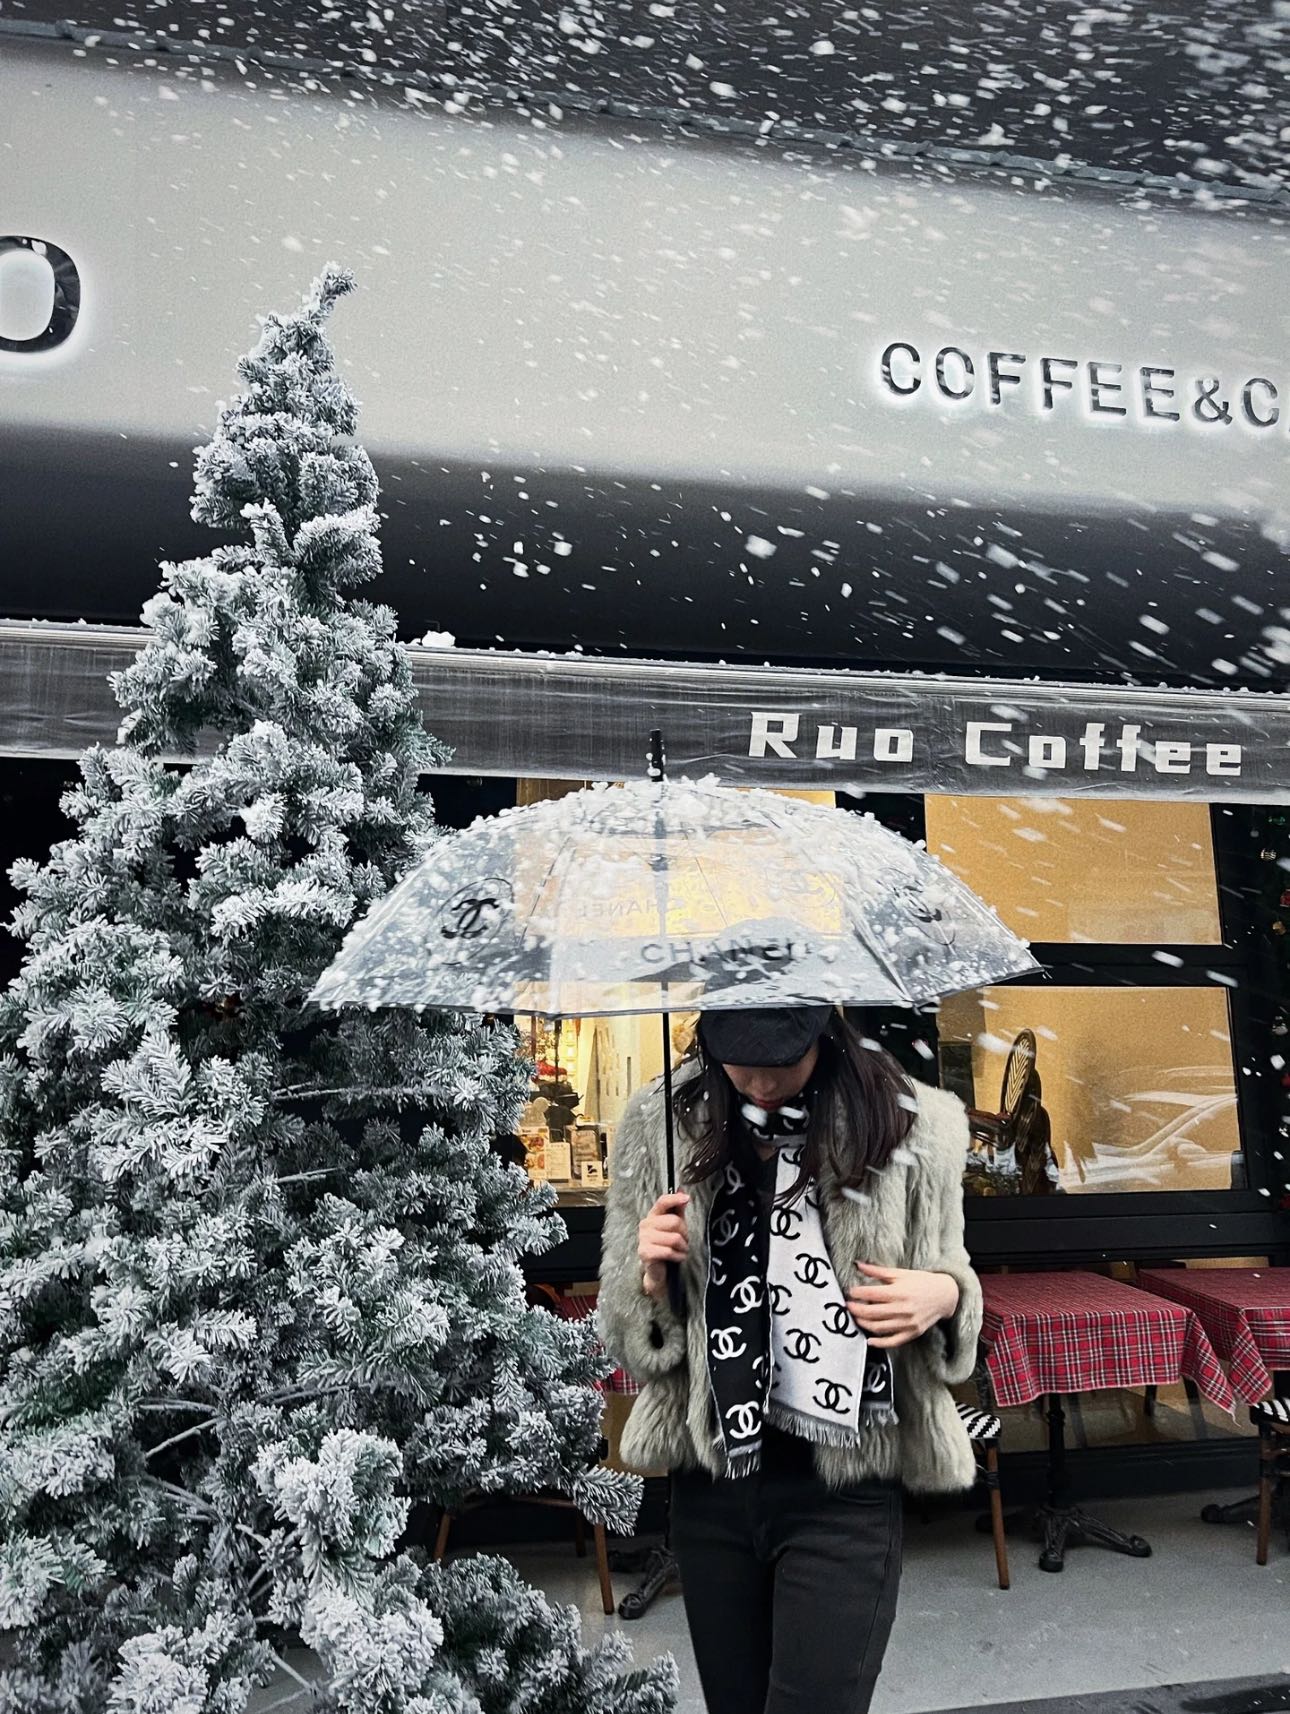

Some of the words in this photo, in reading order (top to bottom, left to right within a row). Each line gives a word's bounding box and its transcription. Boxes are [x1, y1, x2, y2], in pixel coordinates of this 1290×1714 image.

[881, 342, 1290, 432] COFFEE&C
[748, 711, 914, 763] Ruo
[965, 721, 1242, 776] Coffee
